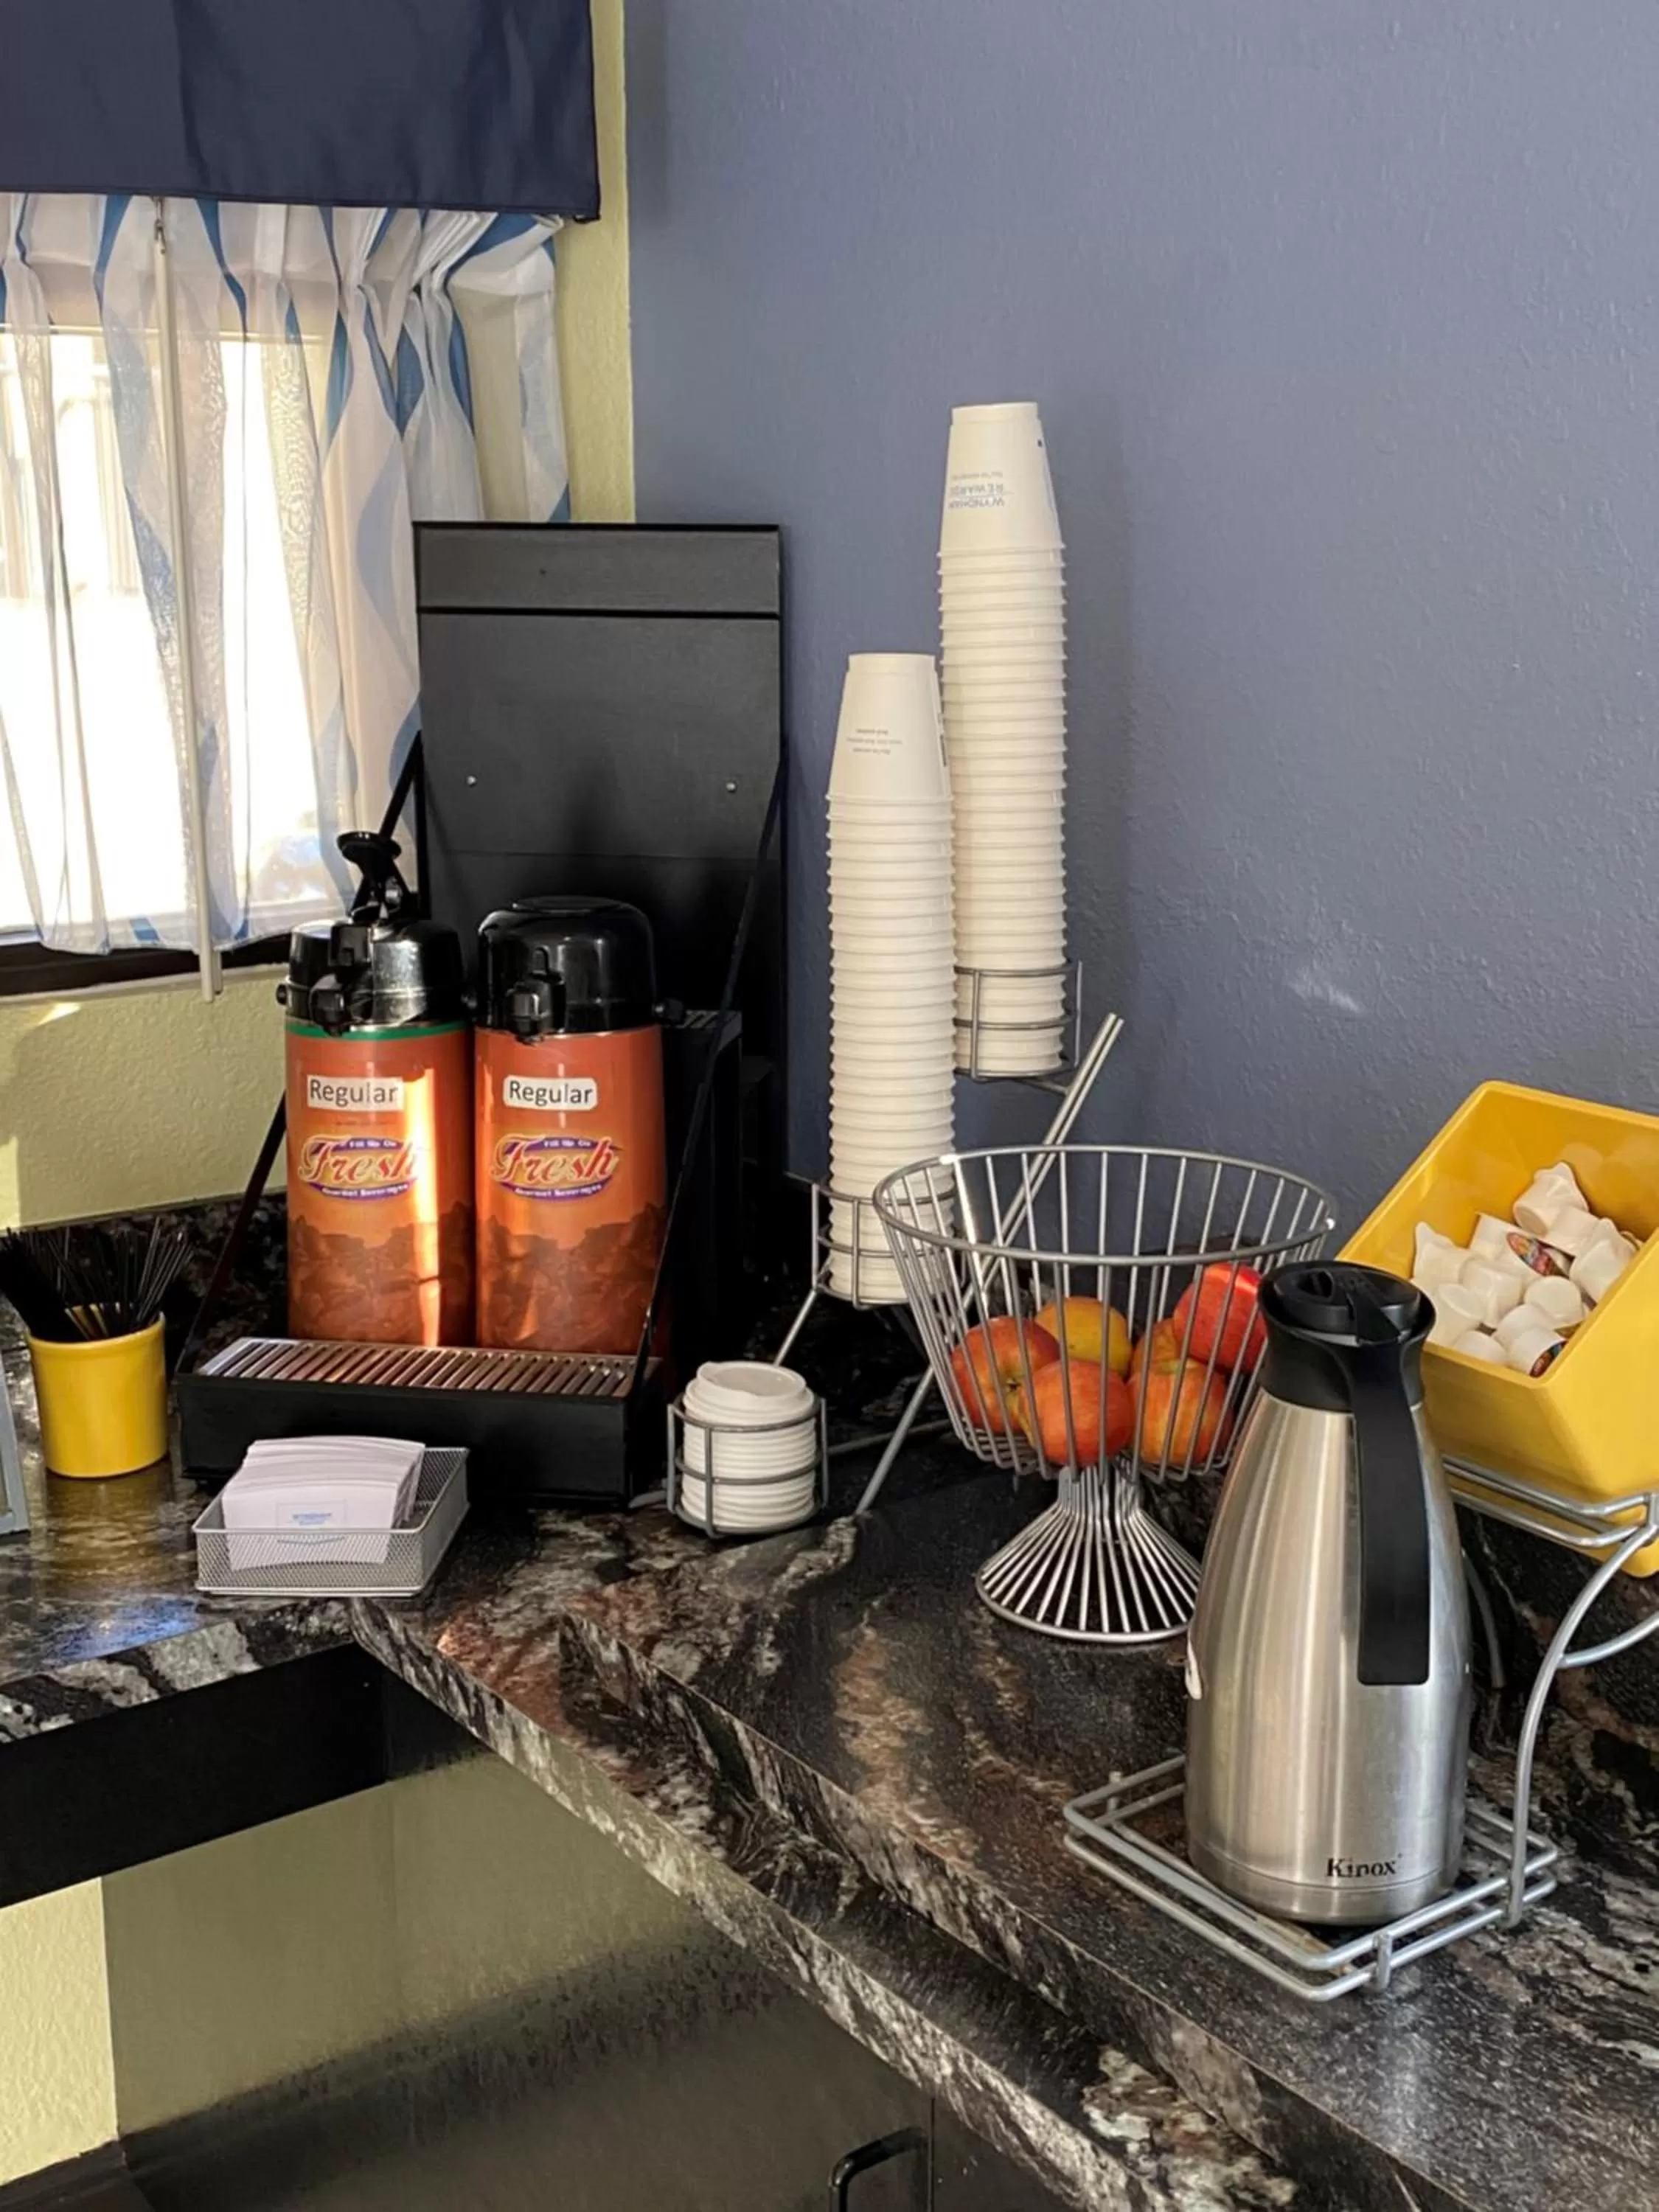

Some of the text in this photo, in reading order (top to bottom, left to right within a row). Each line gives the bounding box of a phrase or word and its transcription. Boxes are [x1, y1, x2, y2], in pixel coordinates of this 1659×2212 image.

[310, 1078, 398, 1107] Regular
[509, 1080, 593, 1107] Regular
[488, 1134, 619, 1184] Fresh
[1326, 1857, 1397, 1878] Kinox
